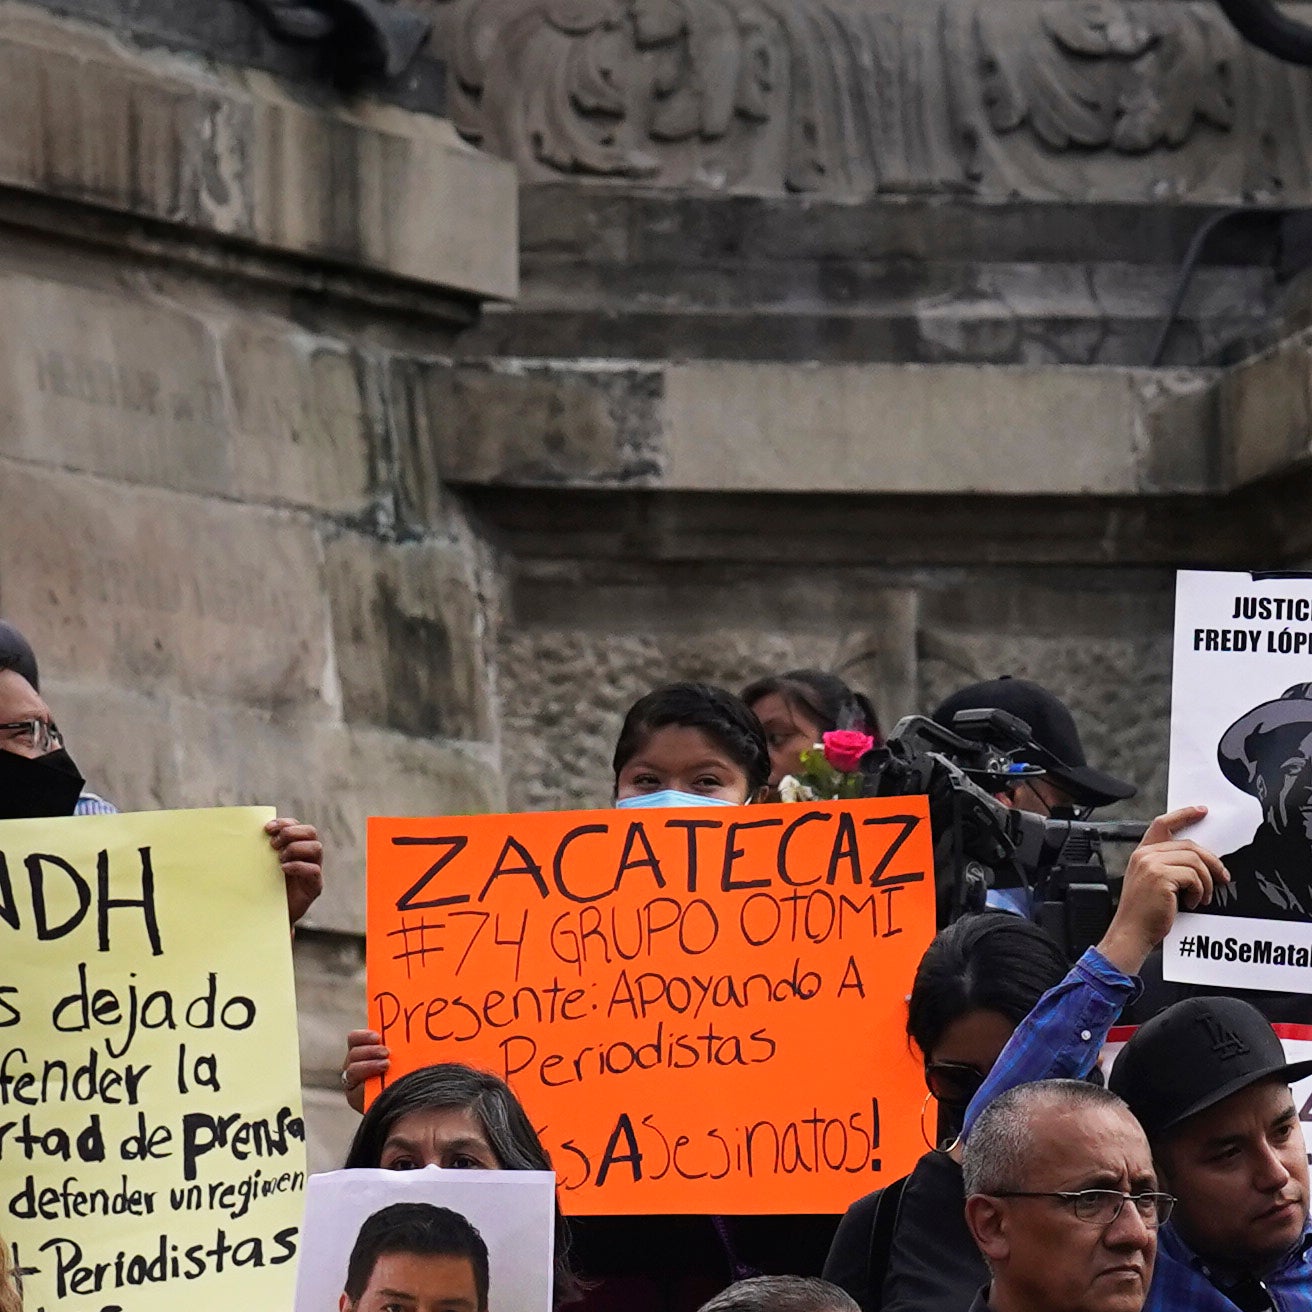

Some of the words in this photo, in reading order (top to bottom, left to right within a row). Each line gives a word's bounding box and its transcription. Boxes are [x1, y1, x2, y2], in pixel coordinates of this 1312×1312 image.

[1192, 627, 1262, 654] FREDY
[391, 811, 925, 912] ZACATECAZ
[386, 909, 529, 982] #74
[550, 896, 719, 978] GRUPO
[838, 955, 867, 1000] A
[52, 962, 257, 1059] dejado
[177, 1043, 221, 1095] la
[499, 1022, 778, 1088] Periodistas
[120, 1111, 174, 1161] de
[8, 1173, 159, 1221] defender
[169, 1182, 202, 1212] un
[38, 1225, 300, 1300] Periodistas
